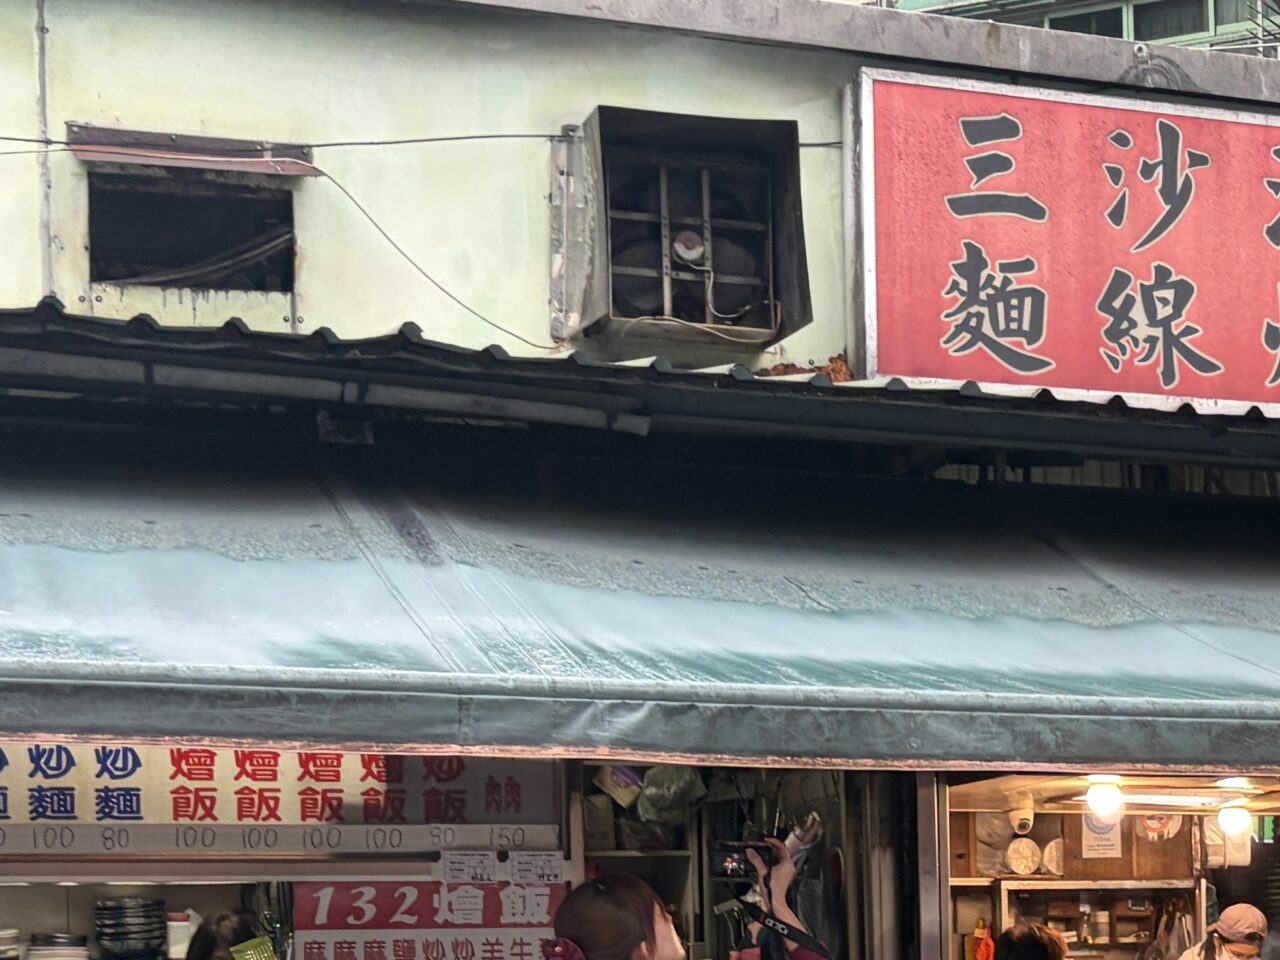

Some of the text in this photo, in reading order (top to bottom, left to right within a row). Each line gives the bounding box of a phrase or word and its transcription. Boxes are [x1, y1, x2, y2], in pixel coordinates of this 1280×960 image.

[28, 744, 78, 821] 炒麵
[95, 745, 143, 820] 炒麵
[170, 748, 218, 821] 燴飯
[234, 750, 281, 821] 燴飯
[297, 753, 344, 822] 燴飯
[33, 827, 74, 848] 100
[102, 827, 129, 850] 80
[175, 827, 215, 848] 100
[242, 827, 278, 848] 100
[302, 827, 341, 848] 100
[366, 828, 401, 848] 100
